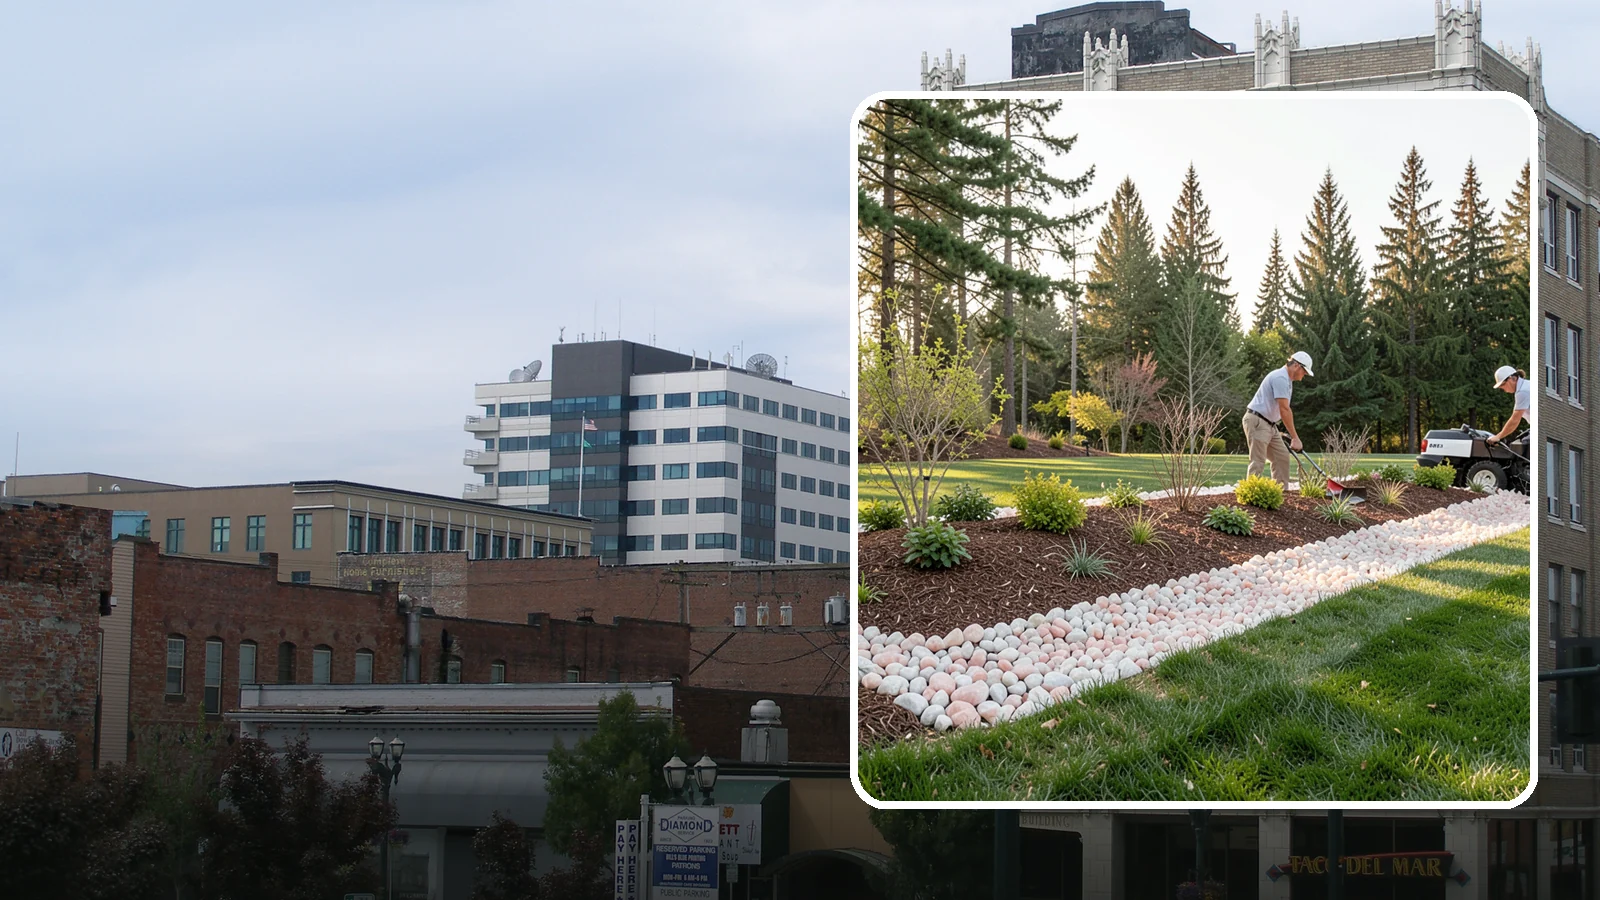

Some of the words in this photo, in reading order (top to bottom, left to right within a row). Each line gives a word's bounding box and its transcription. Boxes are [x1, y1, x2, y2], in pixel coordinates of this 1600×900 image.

[660, 818, 713, 832] DIAMOND
[1022, 815, 1070, 828] BUILDING
[617, 824, 625, 852] PAY
[628, 824, 637, 852] PAY
[655, 845, 688, 853] RESERVED
[689, 846, 716, 854] PARKING
[721, 851, 739, 862] Soup
[671, 862, 701, 870] PATRONS
[1346, 856, 1385, 875] DEL
[1392, 857, 1442, 877] MAR
[616, 855, 625, 894] HERE
[627, 855, 636, 894] HERE
[660, 888, 682, 897] PUBLIC
[683, 889, 710, 899] PARKING
